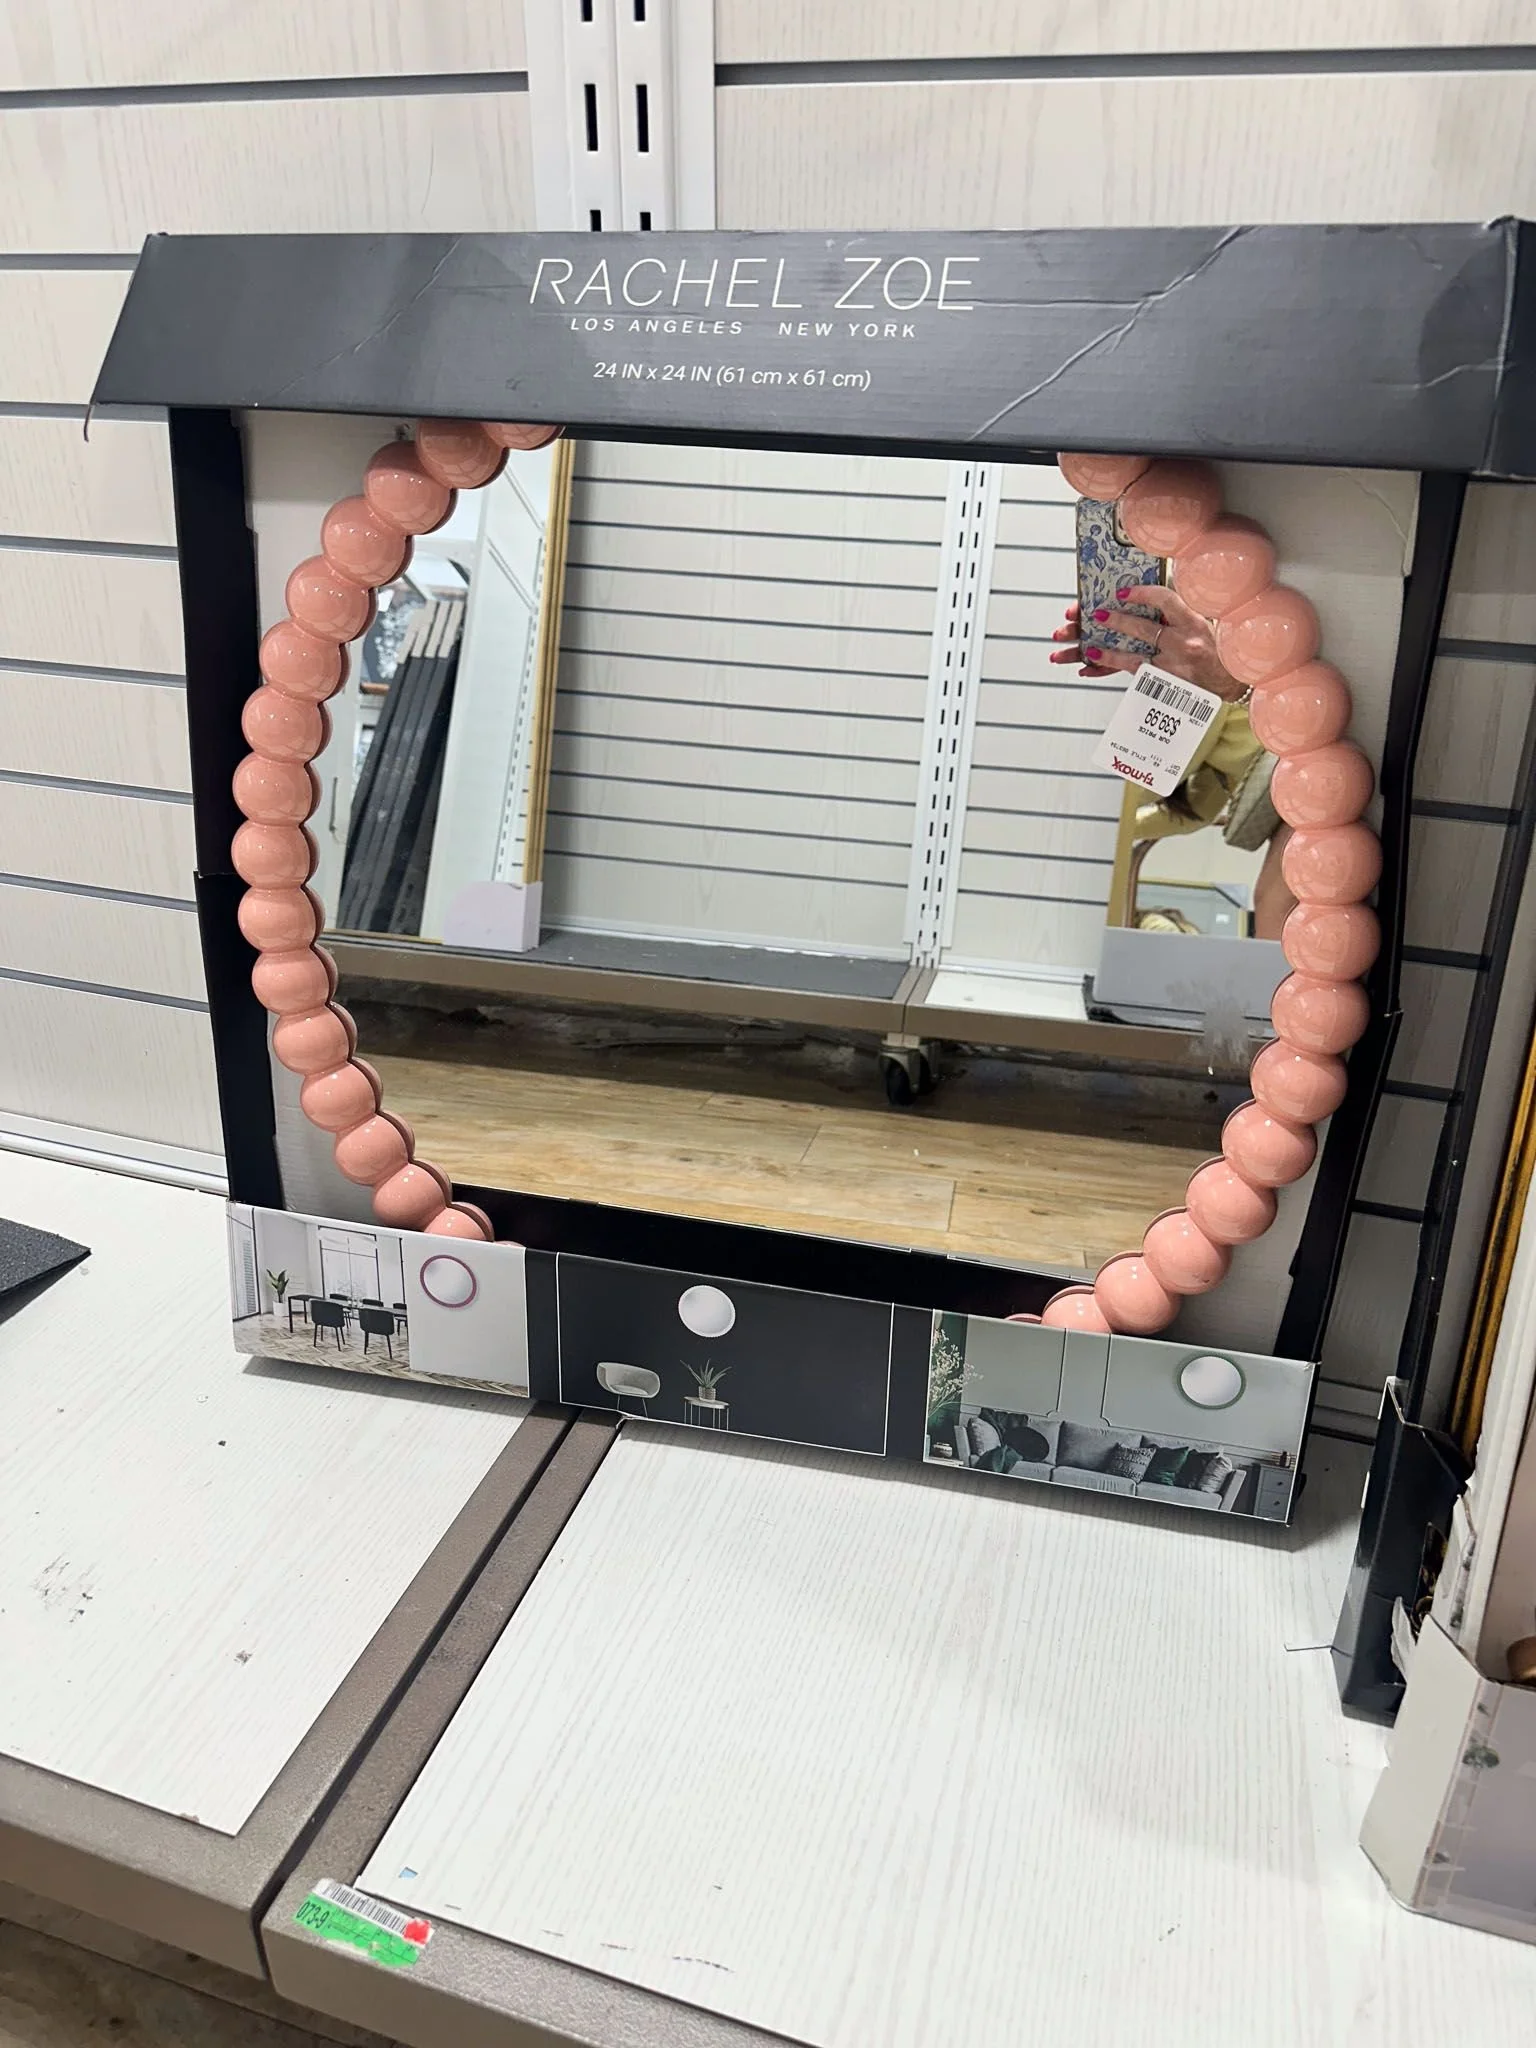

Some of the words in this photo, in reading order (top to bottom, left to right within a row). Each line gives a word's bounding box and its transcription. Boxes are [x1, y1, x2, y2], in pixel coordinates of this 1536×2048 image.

[529, 258, 803, 309] RACHEL
[834, 256, 981, 311] ZOE
[570, 317, 616, 332] LOS
[628, 319, 744, 335] ANGELES
[778, 322, 834, 337] NEW
[848, 323, 917, 338] YORK
[592, 361, 617, 379] 24
[622, 363, 643, 380] IN
[646, 367, 658, 380] x
[661, 365, 686, 382] 24
[690, 366, 712, 382] IN
[716, 365, 745, 387] (61
[751, 370, 782, 386] cm
[786, 372, 799, 386] x
[802, 370, 826, 387] 61
[832, 370, 872, 392] cm)
[1138, 726, 1157, 738] PRICE
[1144, 707, 1181, 737] $39.99
[1158, 735, 1171, 745] OUR
[295, 1900, 330, 1929] 073-9
